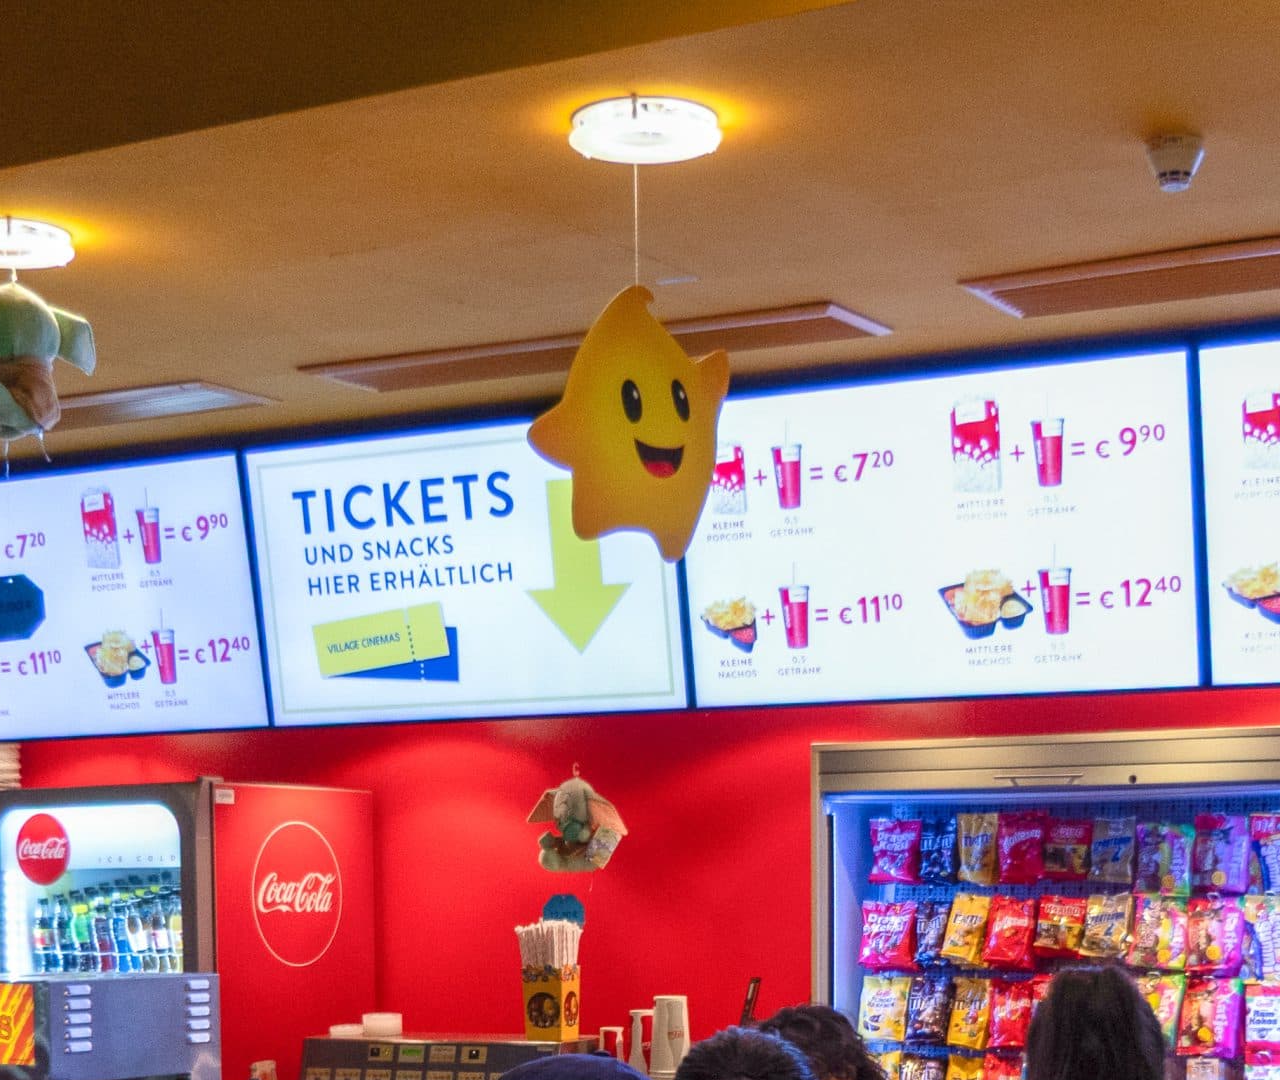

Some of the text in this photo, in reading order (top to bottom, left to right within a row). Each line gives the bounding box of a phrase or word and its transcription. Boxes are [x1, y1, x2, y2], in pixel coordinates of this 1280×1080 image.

[292, 471, 514, 535] TICKETS
[712, 520, 745, 531] KLEINE
[304, 534, 454, 566] UND SNACKS
[308, 561, 513, 596] HIER ERHÄLTLICH
[327, 631, 401, 655] VILLAGE CINEMAS
[718, 668, 758, 679] NACHOS
[720, 657, 754, 668] KLEINE
[21, 837, 66, 860] Coca-Cola
[258, 872, 336, 913] Coca-Cola
